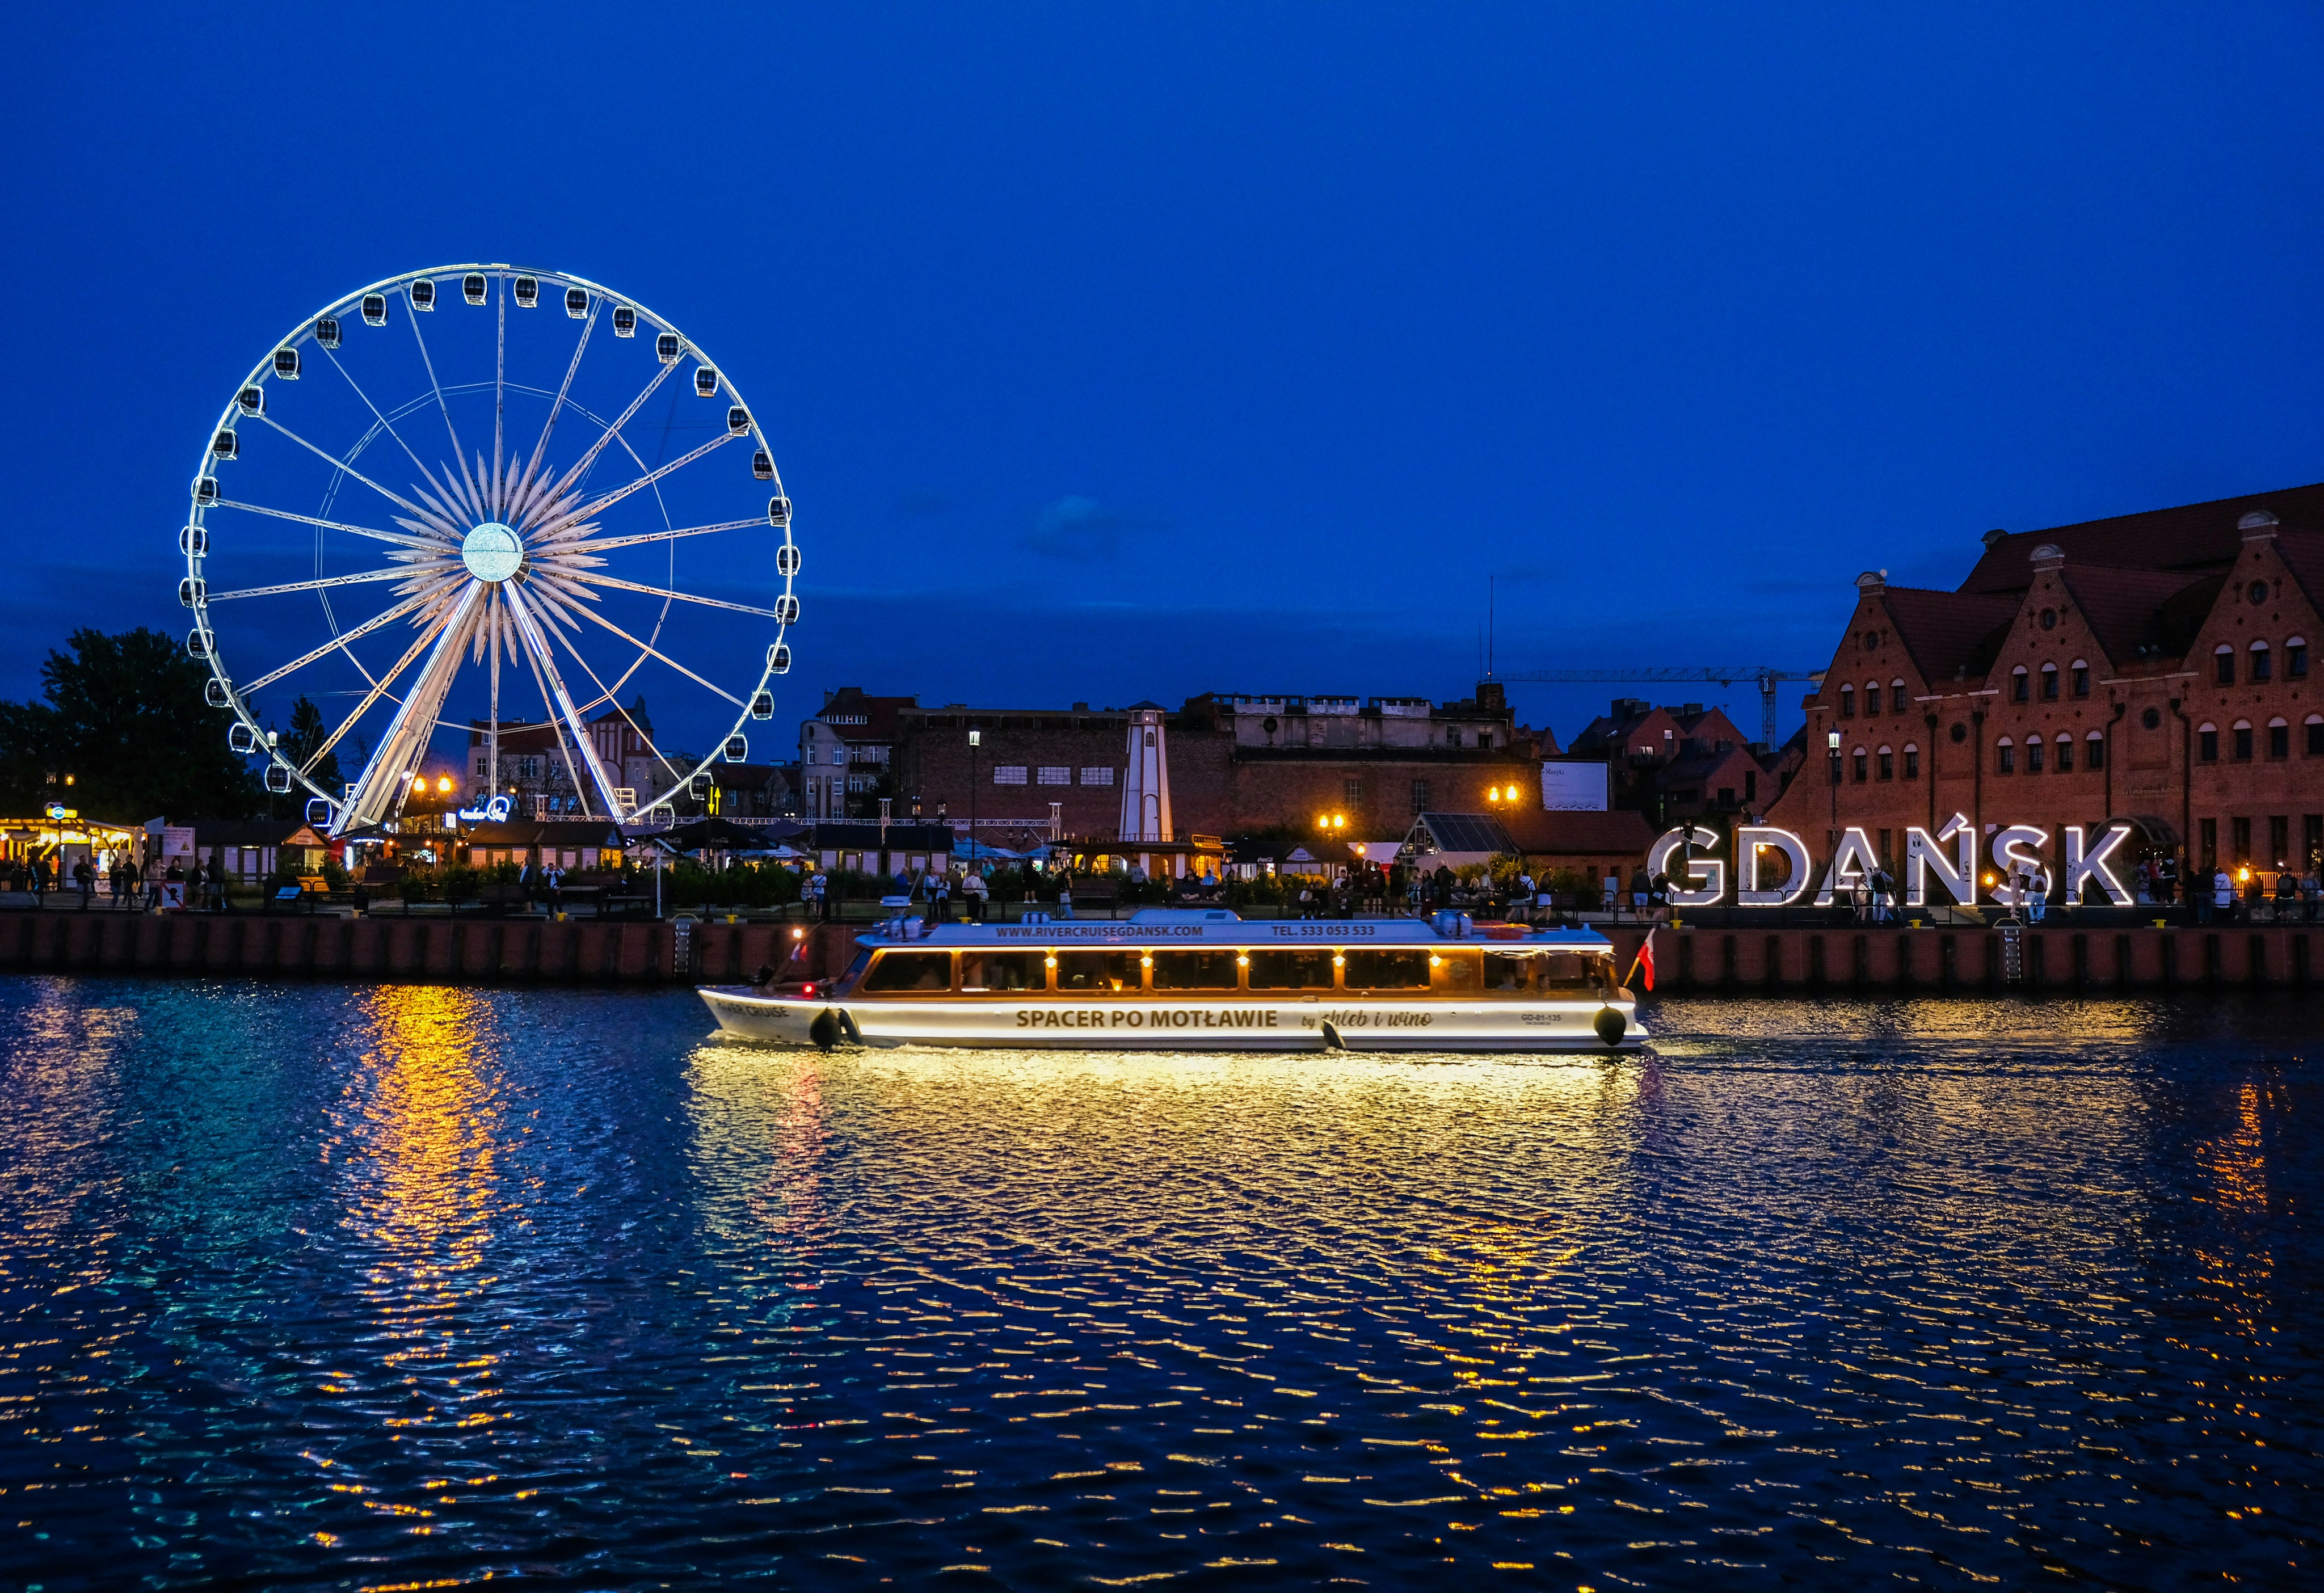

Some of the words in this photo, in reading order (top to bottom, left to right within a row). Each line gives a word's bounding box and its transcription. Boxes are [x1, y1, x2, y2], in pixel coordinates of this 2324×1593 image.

[1647, 811, 2134, 906] GDAŃSK
[996, 926, 1203, 937] WWW.RIVERCRUISEGDANSK.COM
[1272, 926, 1298, 936] TEL.
[1300, 926, 1323, 936] 533
[1326, 926, 1349, 936] 053
[1353, 926, 1375, 936] 533
[1017, 1010, 1105, 1027] SPACER
[1112, 1010, 1144, 1027] PO
[1151, 1010, 1277, 1027] MOTŁAWIE
[1301, 1016, 1315, 1030] by
[1374, 1012, 1383, 1027] i
[1389, 1012, 1434, 1027] wino
